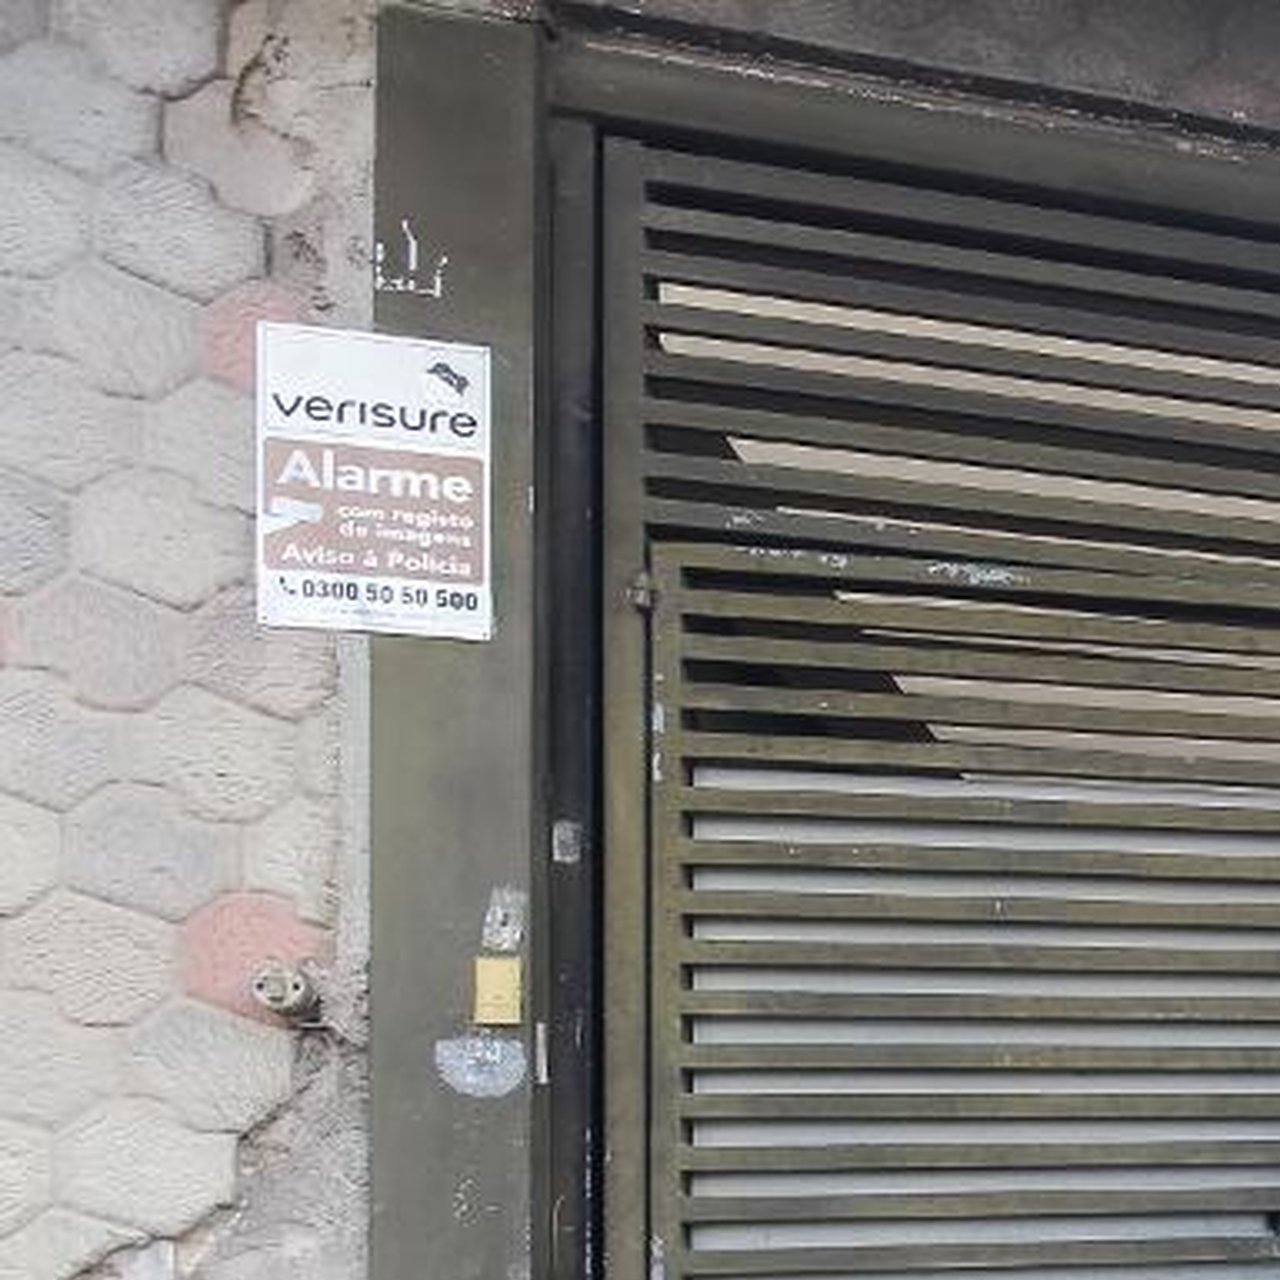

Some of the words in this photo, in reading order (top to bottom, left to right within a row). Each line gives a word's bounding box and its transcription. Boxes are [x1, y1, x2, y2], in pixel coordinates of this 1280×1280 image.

[272, 393, 478, 438] verisure
[276, 449, 473, 502] Alarme
[338, 506, 385, 520] com
[338, 520, 368, 538] de
[376, 523, 472, 548] imagens
[281, 543, 354, 565] Aviso
[302, 579, 359, 601] 0300
[366, 584, 394, 604] 50
[401, 586, 428, 607] 50
[436, 589, 478, 611] 500
